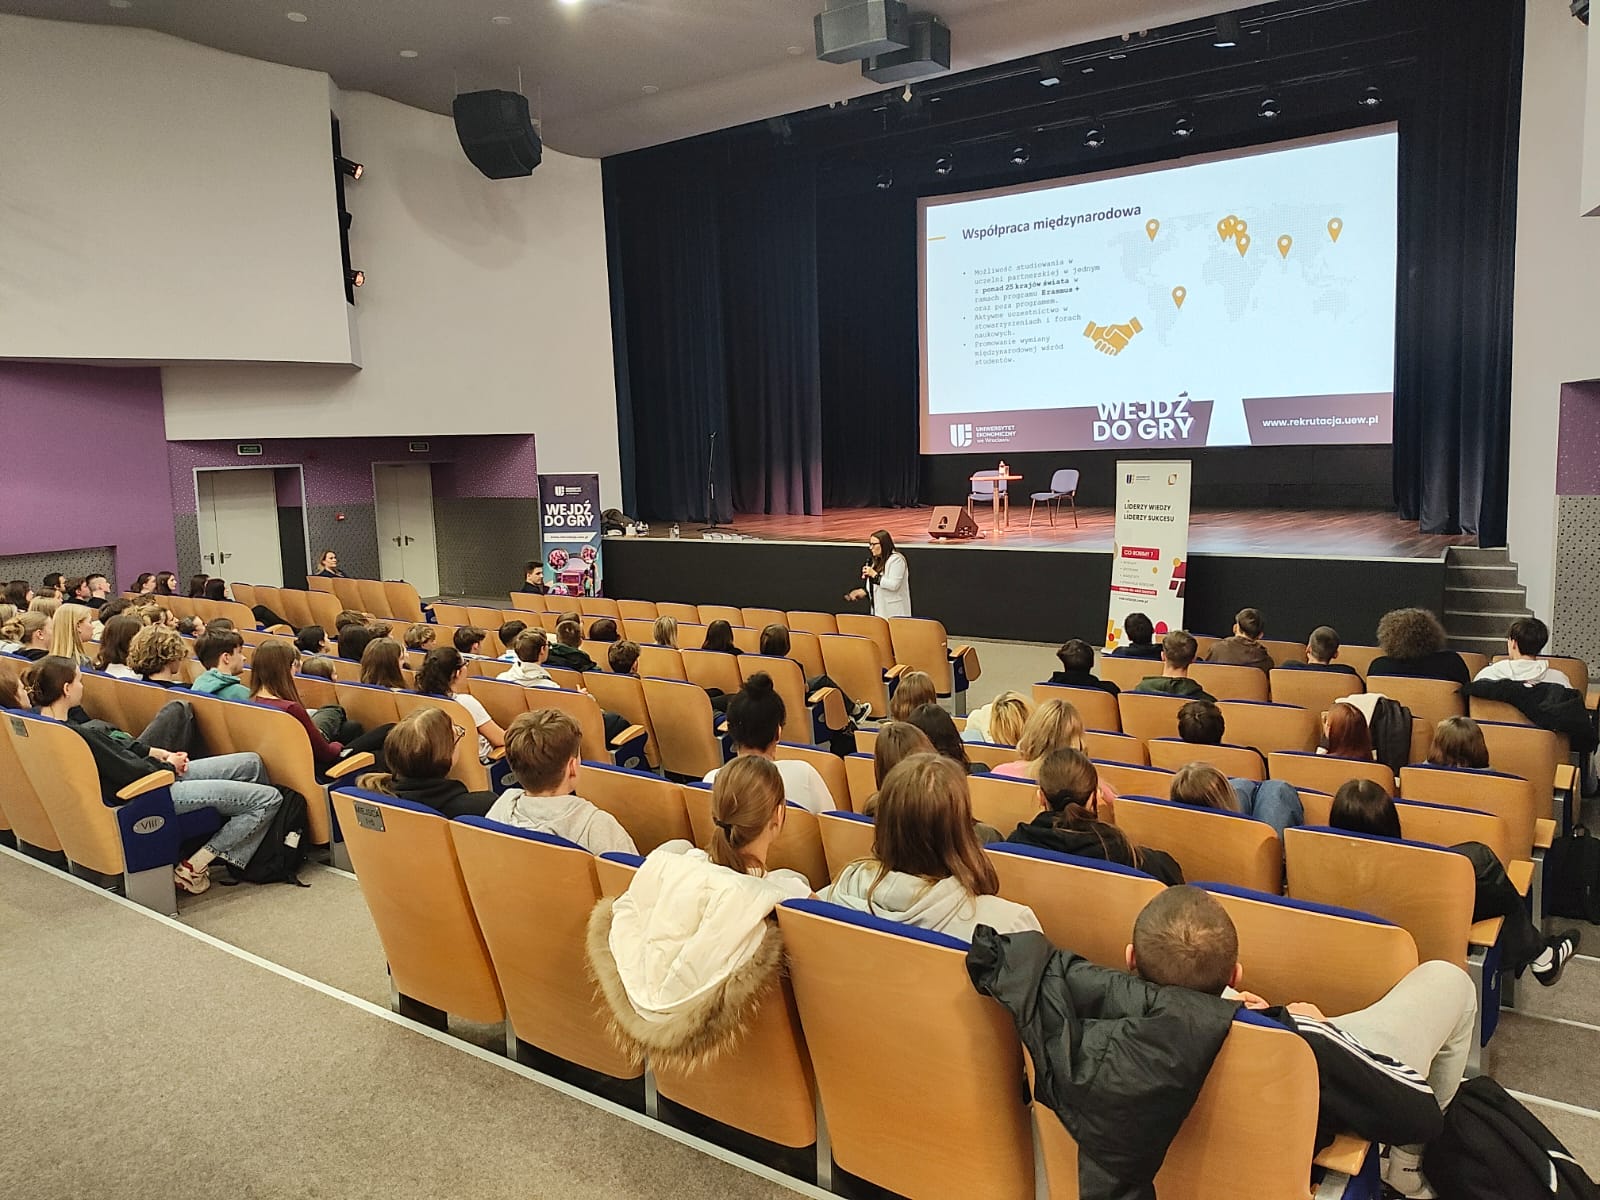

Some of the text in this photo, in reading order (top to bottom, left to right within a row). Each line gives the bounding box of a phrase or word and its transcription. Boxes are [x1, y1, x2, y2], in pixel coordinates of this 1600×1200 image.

[962, 206, 1142, 241] Współpraca międzynarodowa
[1015, 259, 1064, 271] studiowania
[974, 276, 1004, 285] uczelni
[1007, 269, 1060, 282] partnerskiej
[1072, 264, 1101, 275] jednym
[982, 284, 1004, 294] ponad
[1014, 281, 1041, 290] krajów
[1043, 278, 1070, 287] świata
[974, 294, 1000, 303] ramach
[1003, 291, 1038, 302] programu
[1041, 287, 1073, 296] Erasmus
[1007, 307, 1060, 318] uczestnictwo
[1054, 313, 1082, 322] forach
[974, 330, 1016, 339] naukowych.
[974, 335, 1051, 348] Promowanie wymiany
[974, 343, 1064, 358] międzynarodowej wśród
[975, 356, 1016, 366] studentów.
[1096, 391, 1191, 421] WEJDŹ
[1262, 415, 1379, 428] www.rekrutacja.uew.pl
[1092, 416, 1194, 441] DO GRY
[545, 499, 592, 516] WEJDŹ
[544, 514, 594, 527] DO GRY
[1123, 513, 1175, 522] LIDERZY SUKCESU
[140, 819, 158, 830] VIII
